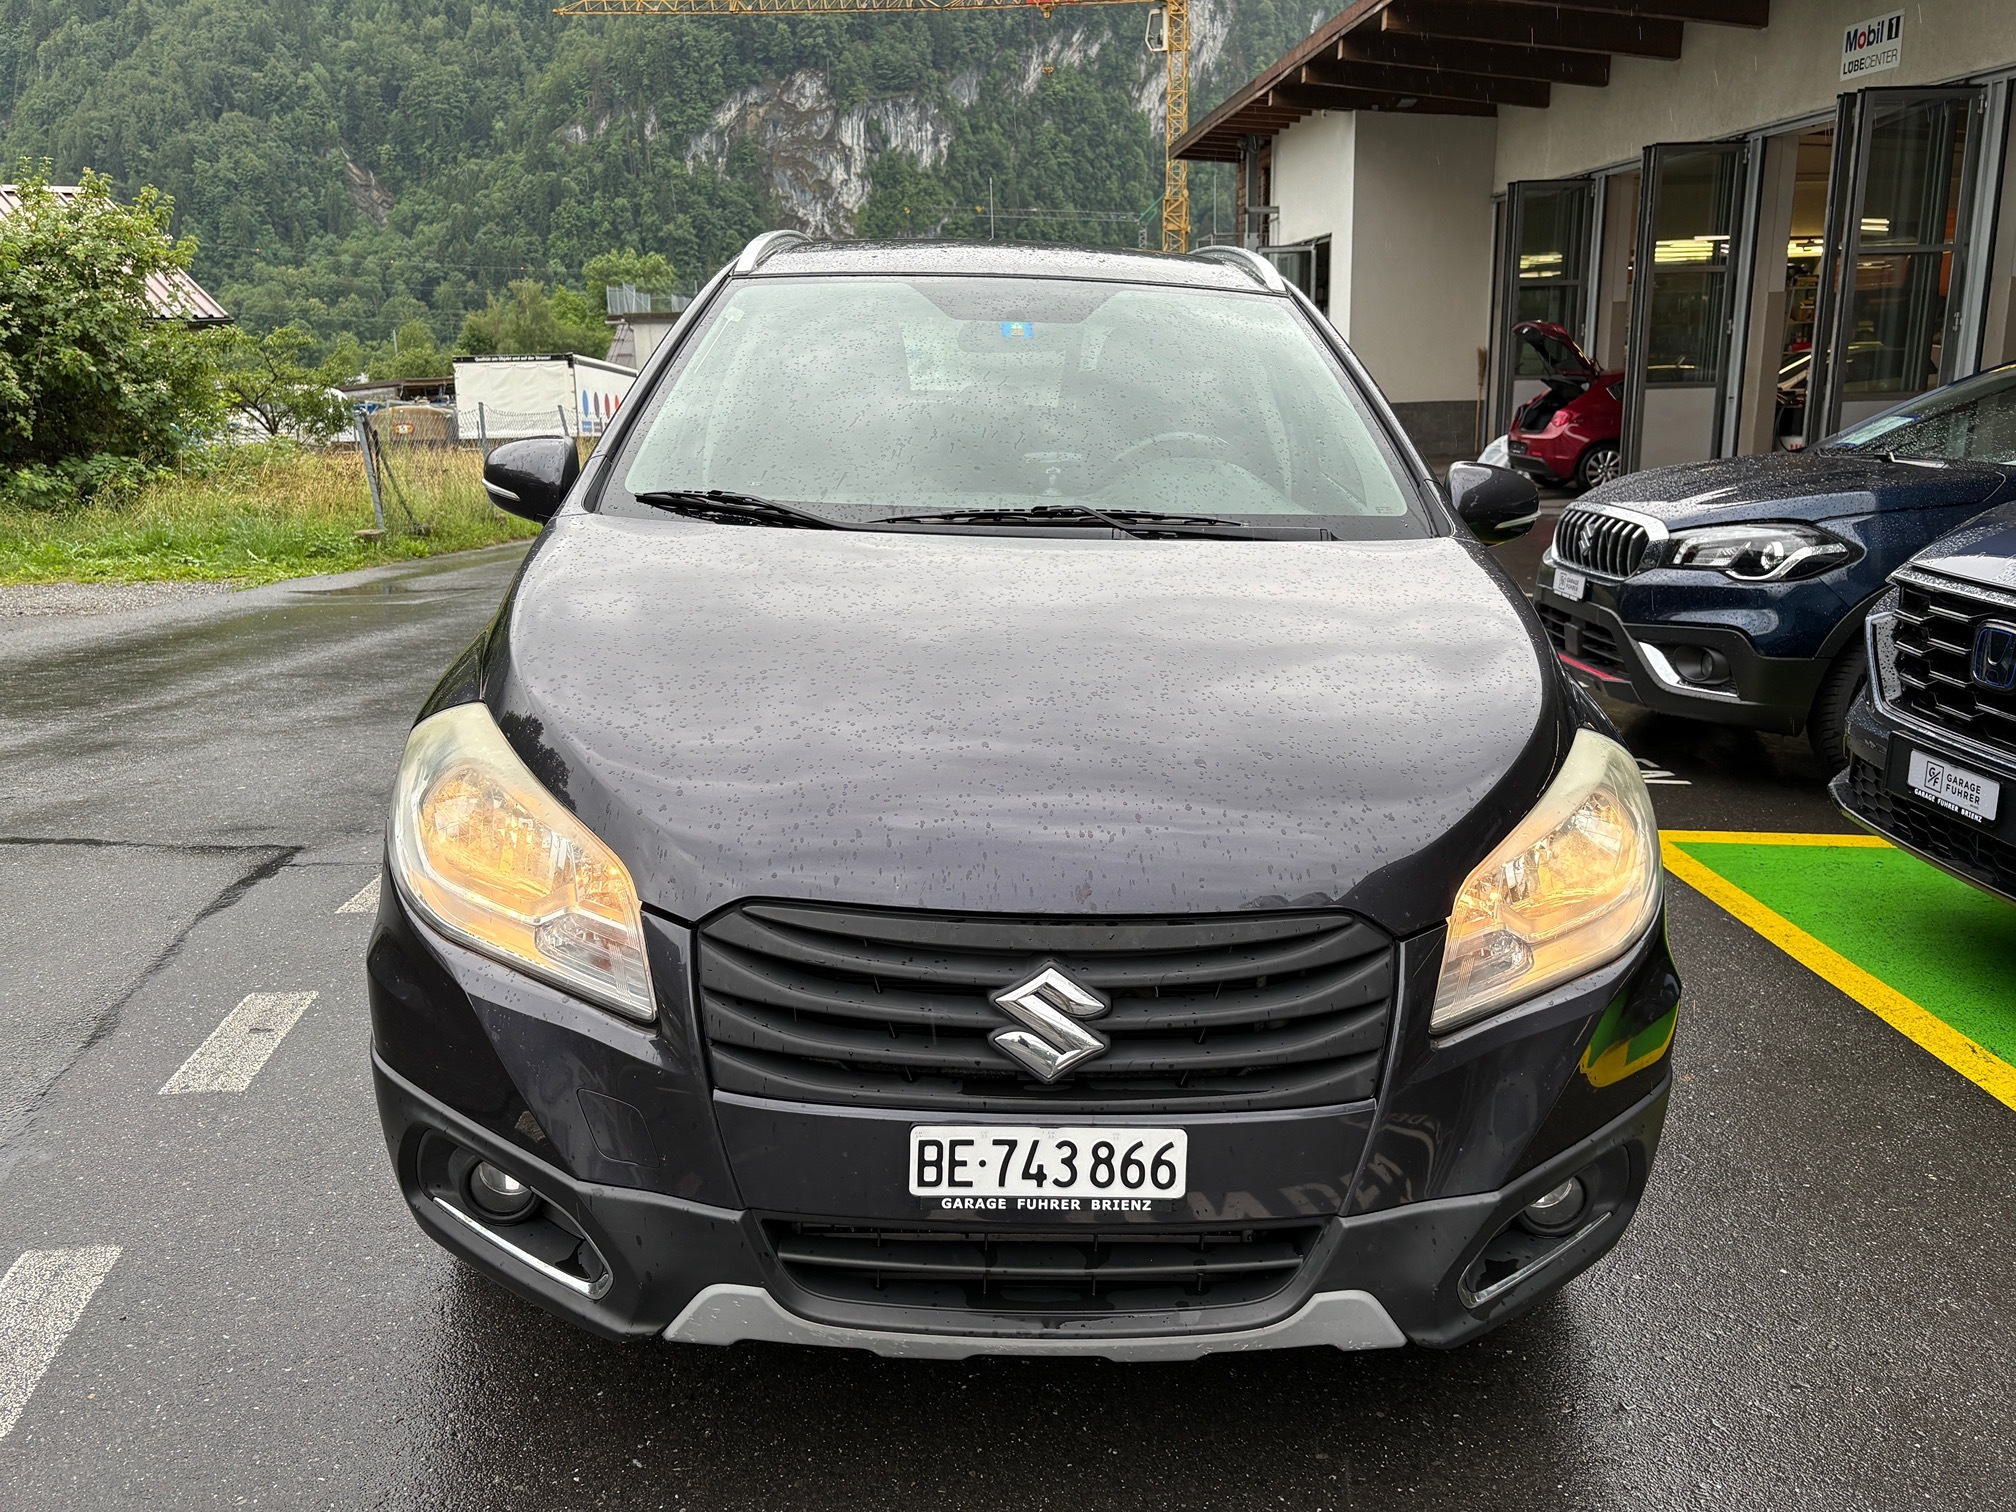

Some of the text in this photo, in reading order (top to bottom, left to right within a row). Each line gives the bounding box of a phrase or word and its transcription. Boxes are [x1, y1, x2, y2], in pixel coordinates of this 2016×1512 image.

[1845, 20, 1884, 53] Mobil
[1945, 784, 1981, 805] FUHRER
[1946, 773, 1981, 795] GARAGE
[1914, 788, 1935, 803] GARAGE
[1937, 798, 1959, 813] FUHRER
[1961, 808, 1983, 823] BRIENZ
[941, 1197, 1152, 1211] GARAGE FUHRER BRIENZ
